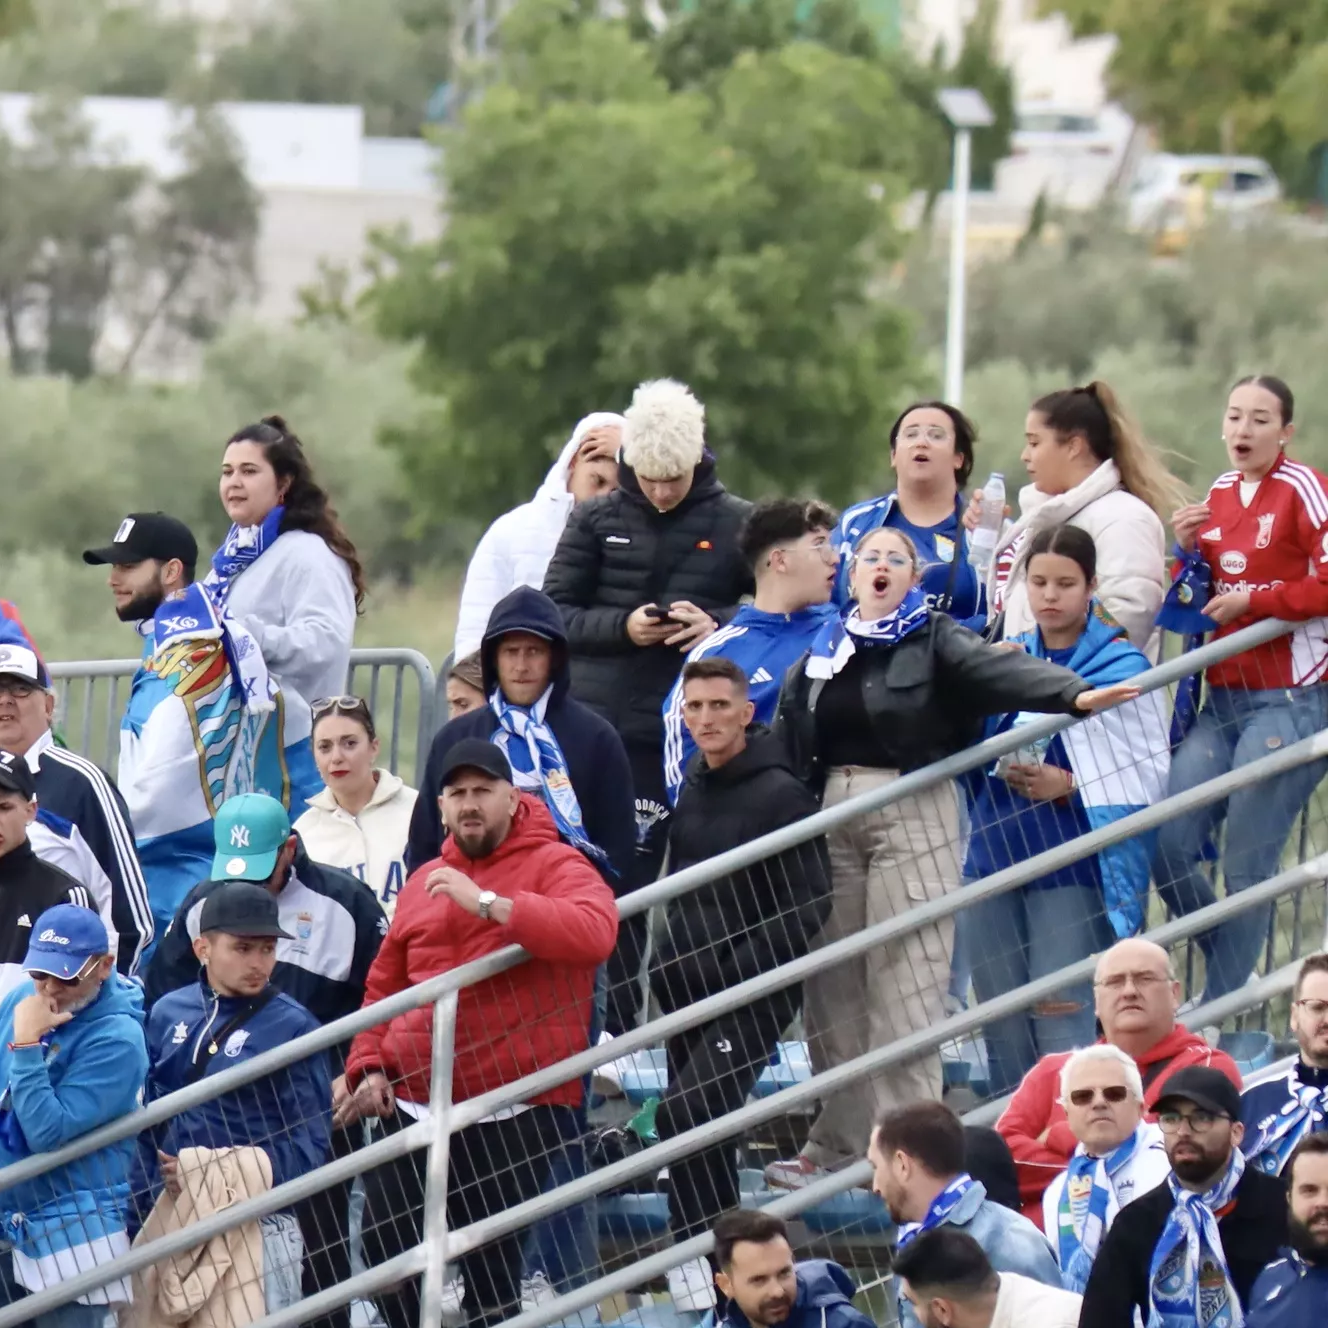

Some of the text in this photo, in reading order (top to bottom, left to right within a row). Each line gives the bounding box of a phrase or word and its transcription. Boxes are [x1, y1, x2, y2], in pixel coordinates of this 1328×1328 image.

[1222, 560, 1244, 568] LUGO
[635, 798, 670, 821] ODRICH
[230, 824, 250, 848] NY
[38, 929, 71, 945] Pisa
